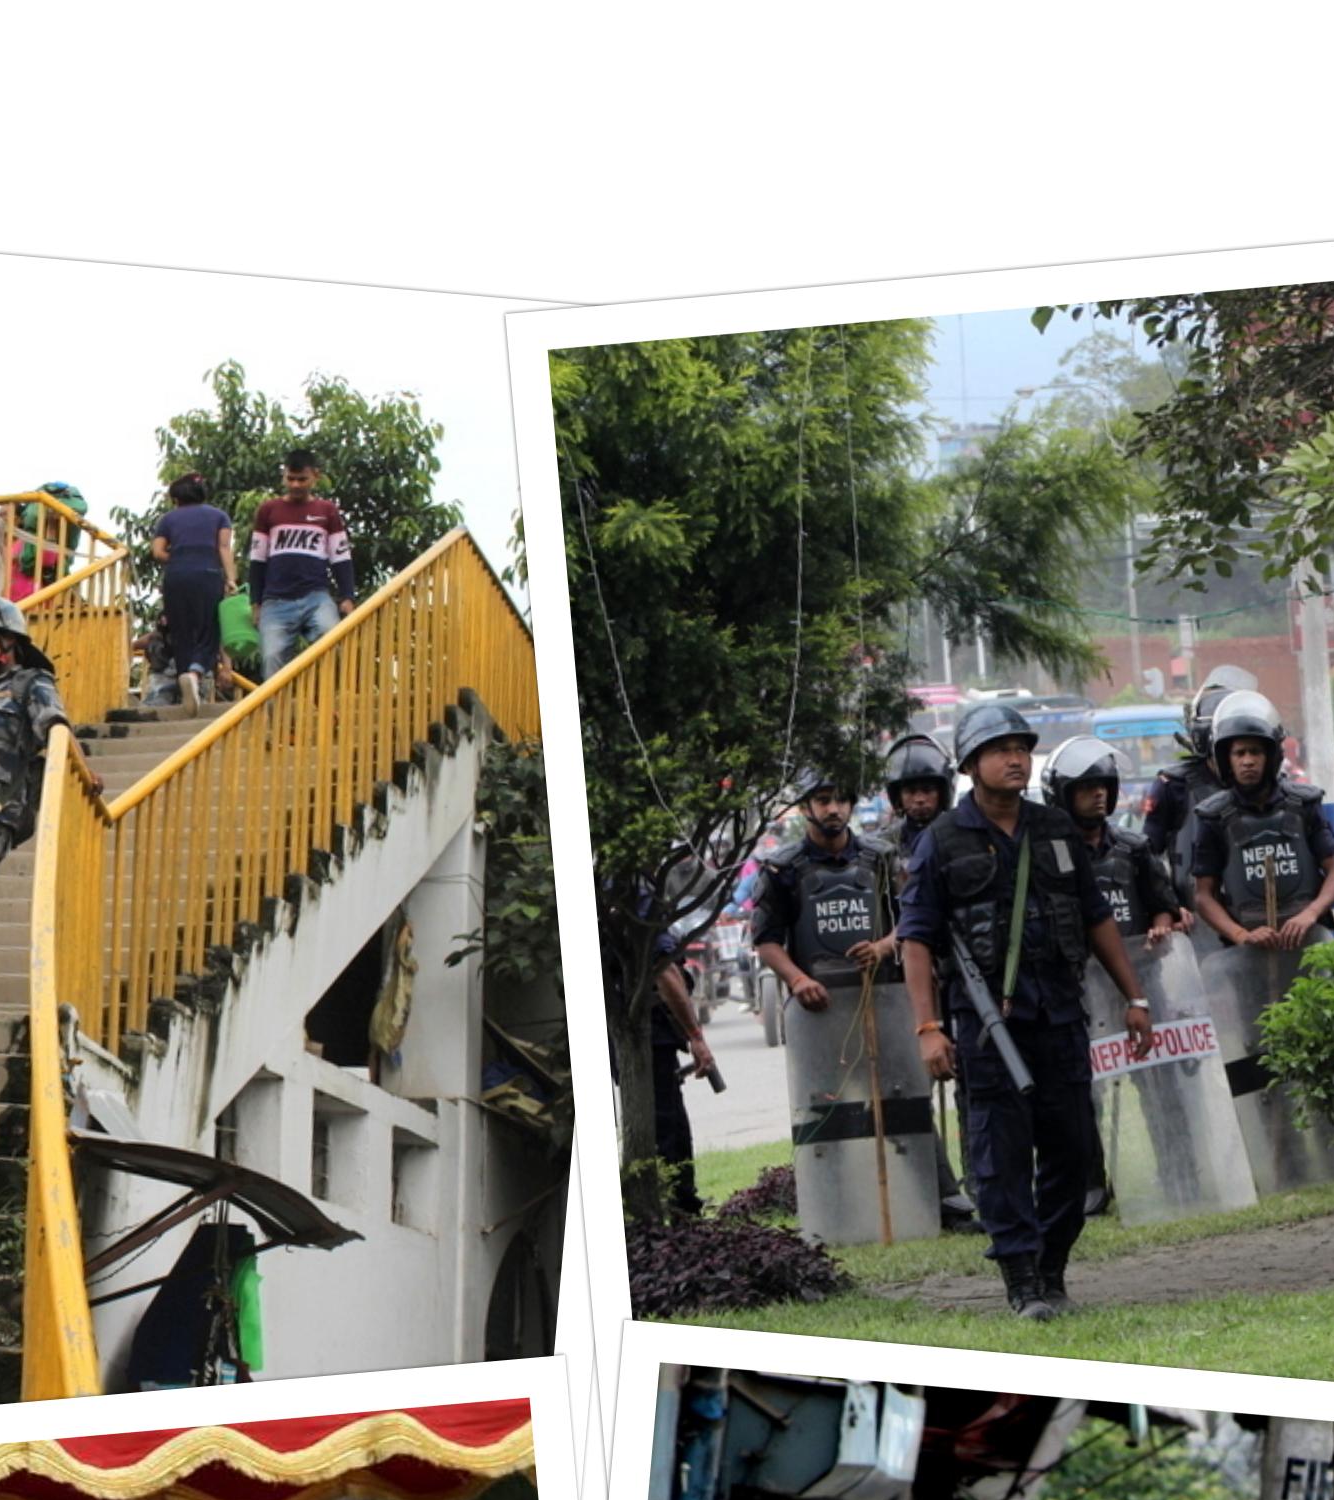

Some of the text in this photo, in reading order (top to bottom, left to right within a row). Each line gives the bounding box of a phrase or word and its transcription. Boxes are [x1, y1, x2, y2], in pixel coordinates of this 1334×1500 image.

[275, 529, 322, 551] NIKE
[1242, 842, 1296, 864] NEPAL
[1246, 859, 1299, 882] POICE
[815, 898, 870, 918] NEPAL
[817, 915, 871, 935] POLICE
[1153, 1023, 1216, 1059] POLICE
